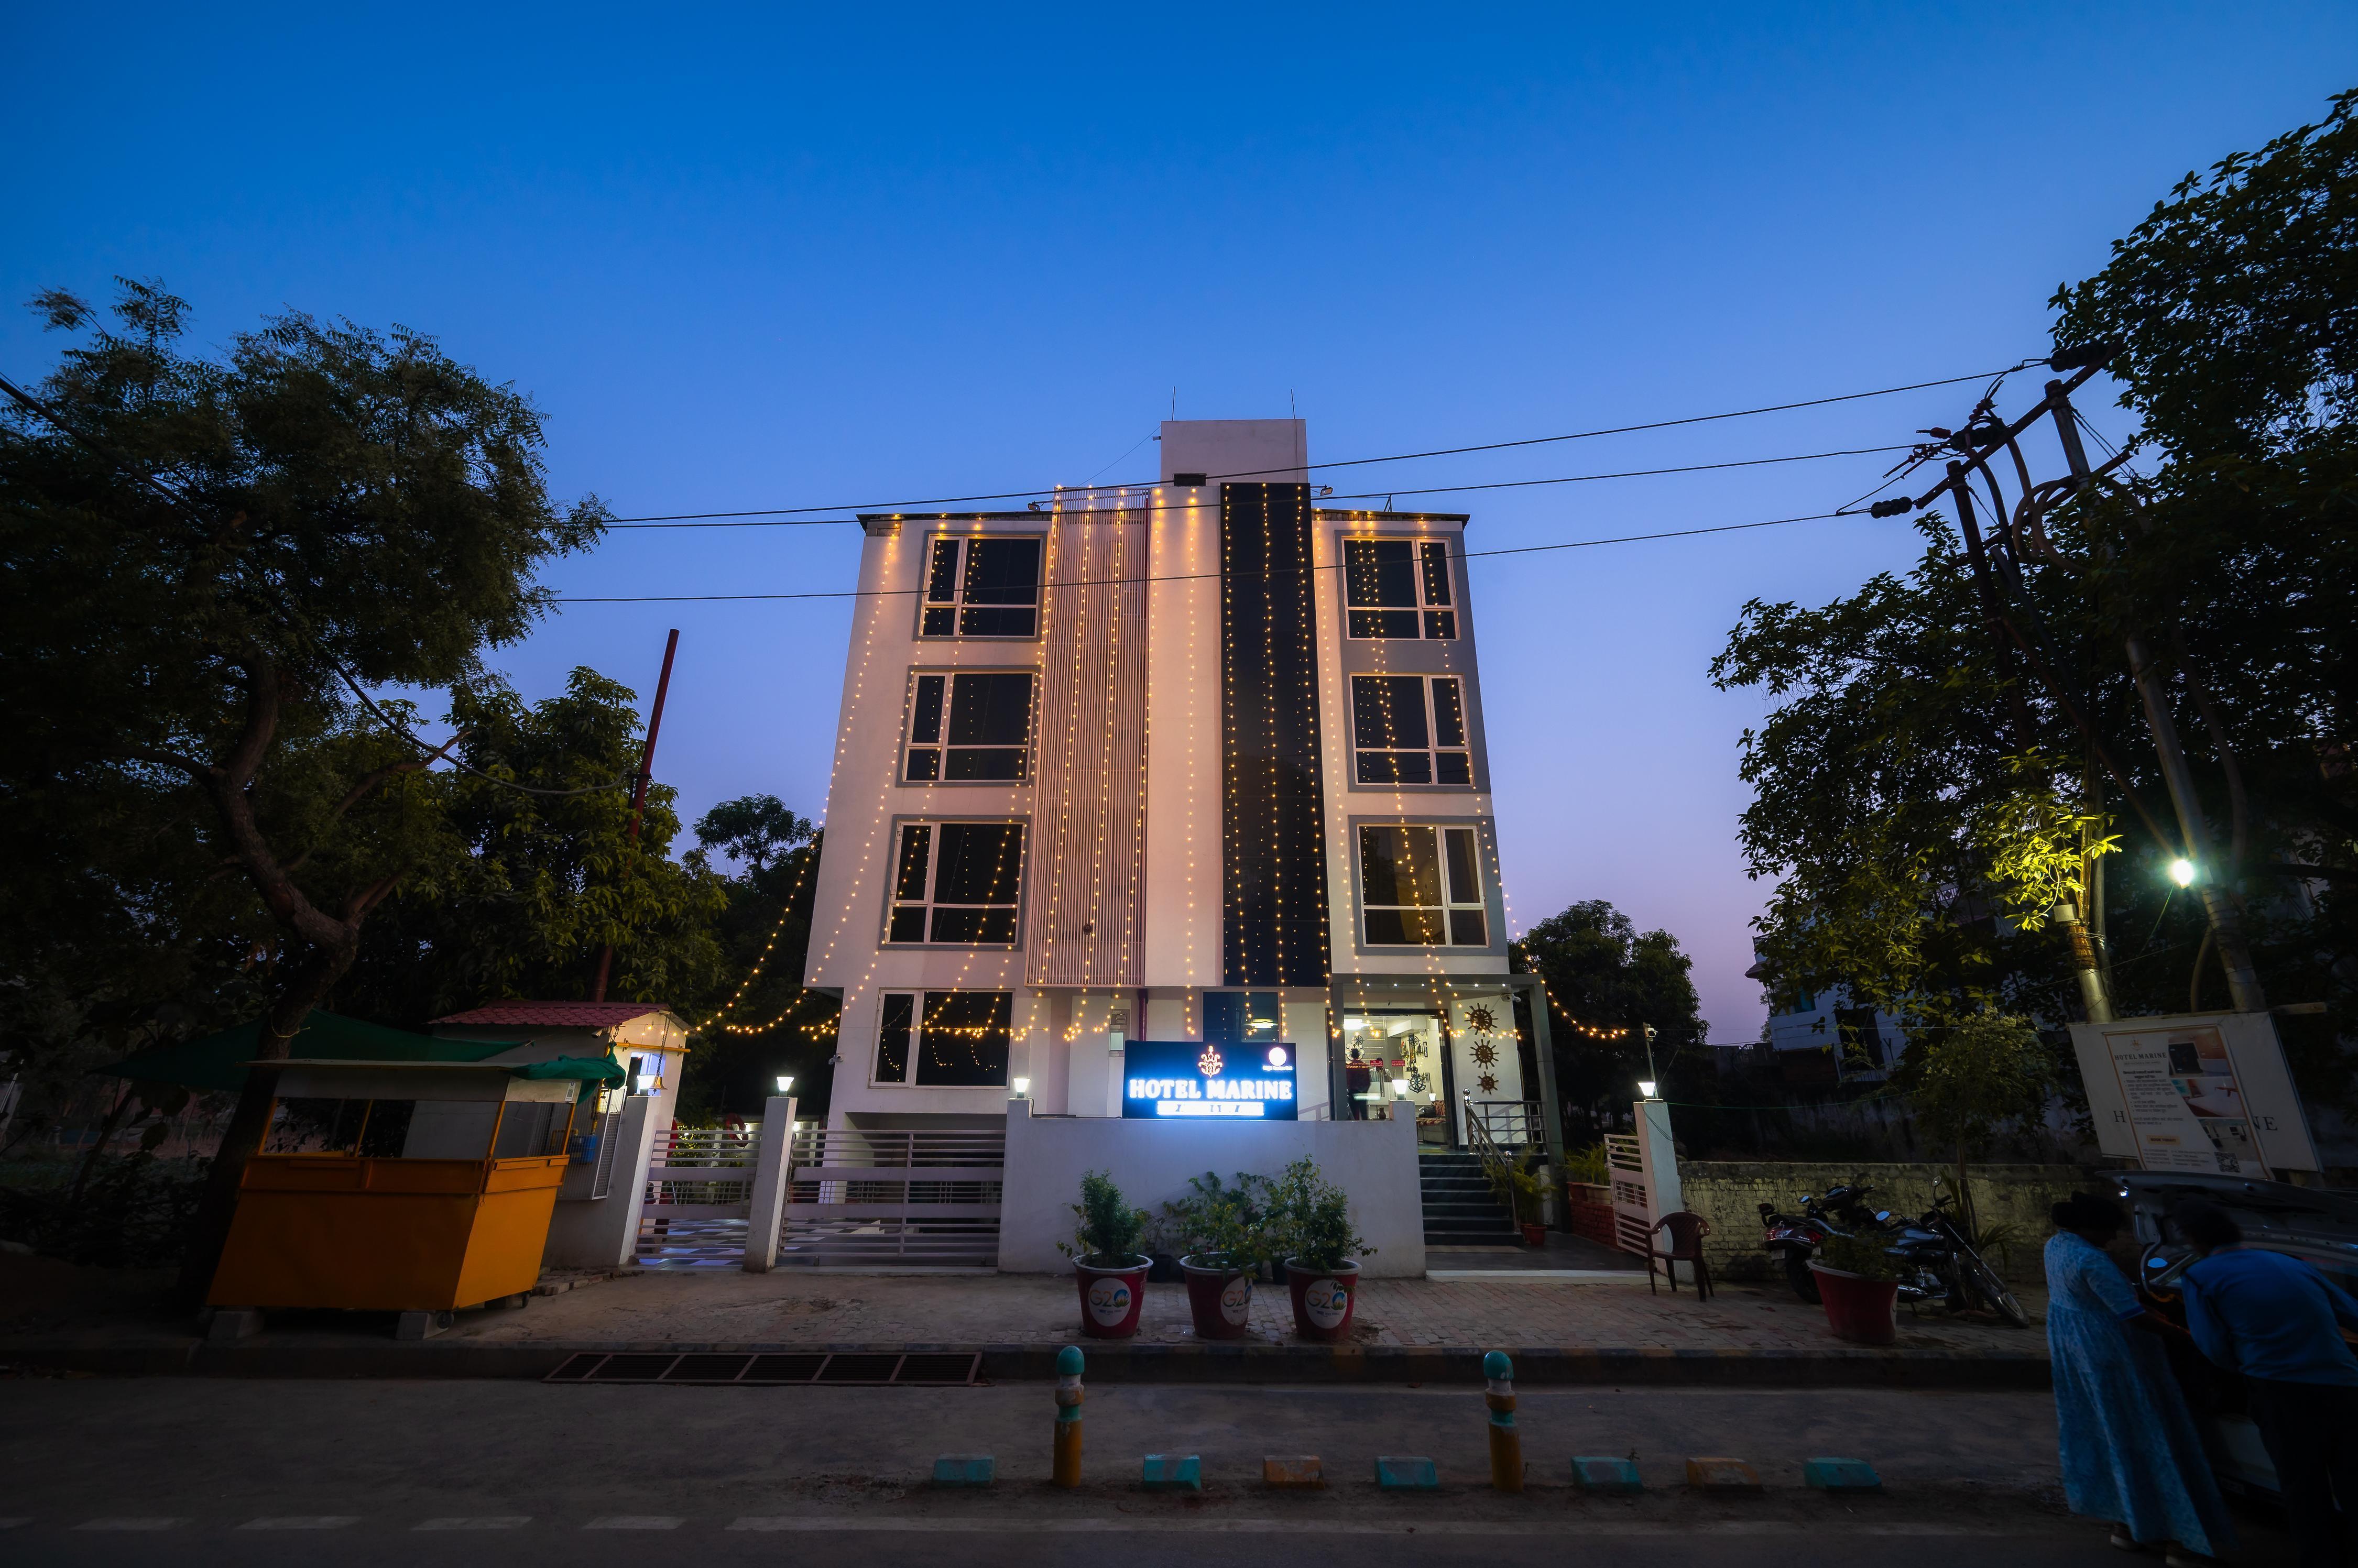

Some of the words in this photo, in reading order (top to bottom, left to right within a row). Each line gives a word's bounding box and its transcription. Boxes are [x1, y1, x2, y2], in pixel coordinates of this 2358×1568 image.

[1129, 1079, 1201, 1099] HOTEL
[1206, 1079, 1293, 1100] MARINE
[1089, 1289, 1130, 1308] G20
[1222, 1285, 1252, 1308] G20
[1307, 1289, 1346, 1311] G20
